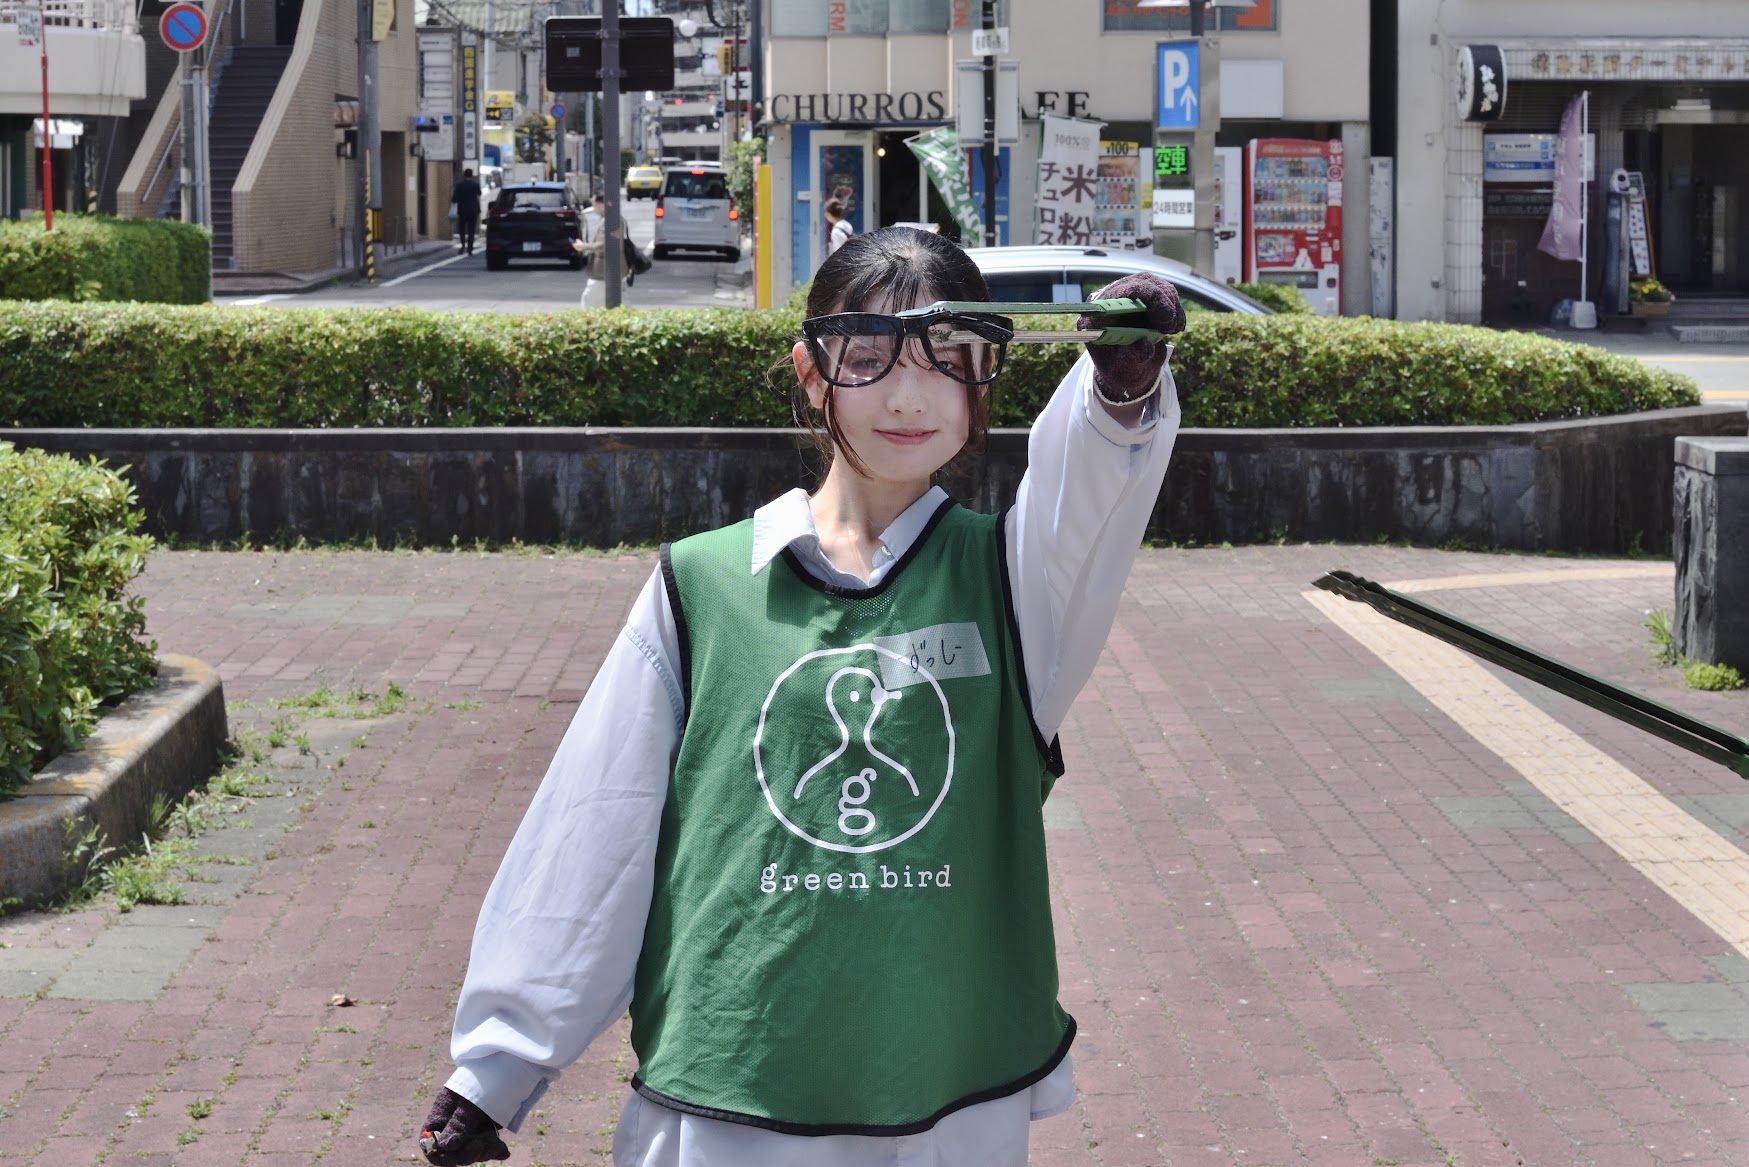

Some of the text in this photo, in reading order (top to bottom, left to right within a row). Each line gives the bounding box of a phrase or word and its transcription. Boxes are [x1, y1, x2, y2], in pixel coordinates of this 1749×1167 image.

[1164, 50, 1189, 109] P
[771, 91, 945, 122] CHURROS
[1155, 145, 1187, 175] 空車
[1153, 201, 1193, 214] 24時間営業
[760, 862, 951, 893] green bird
